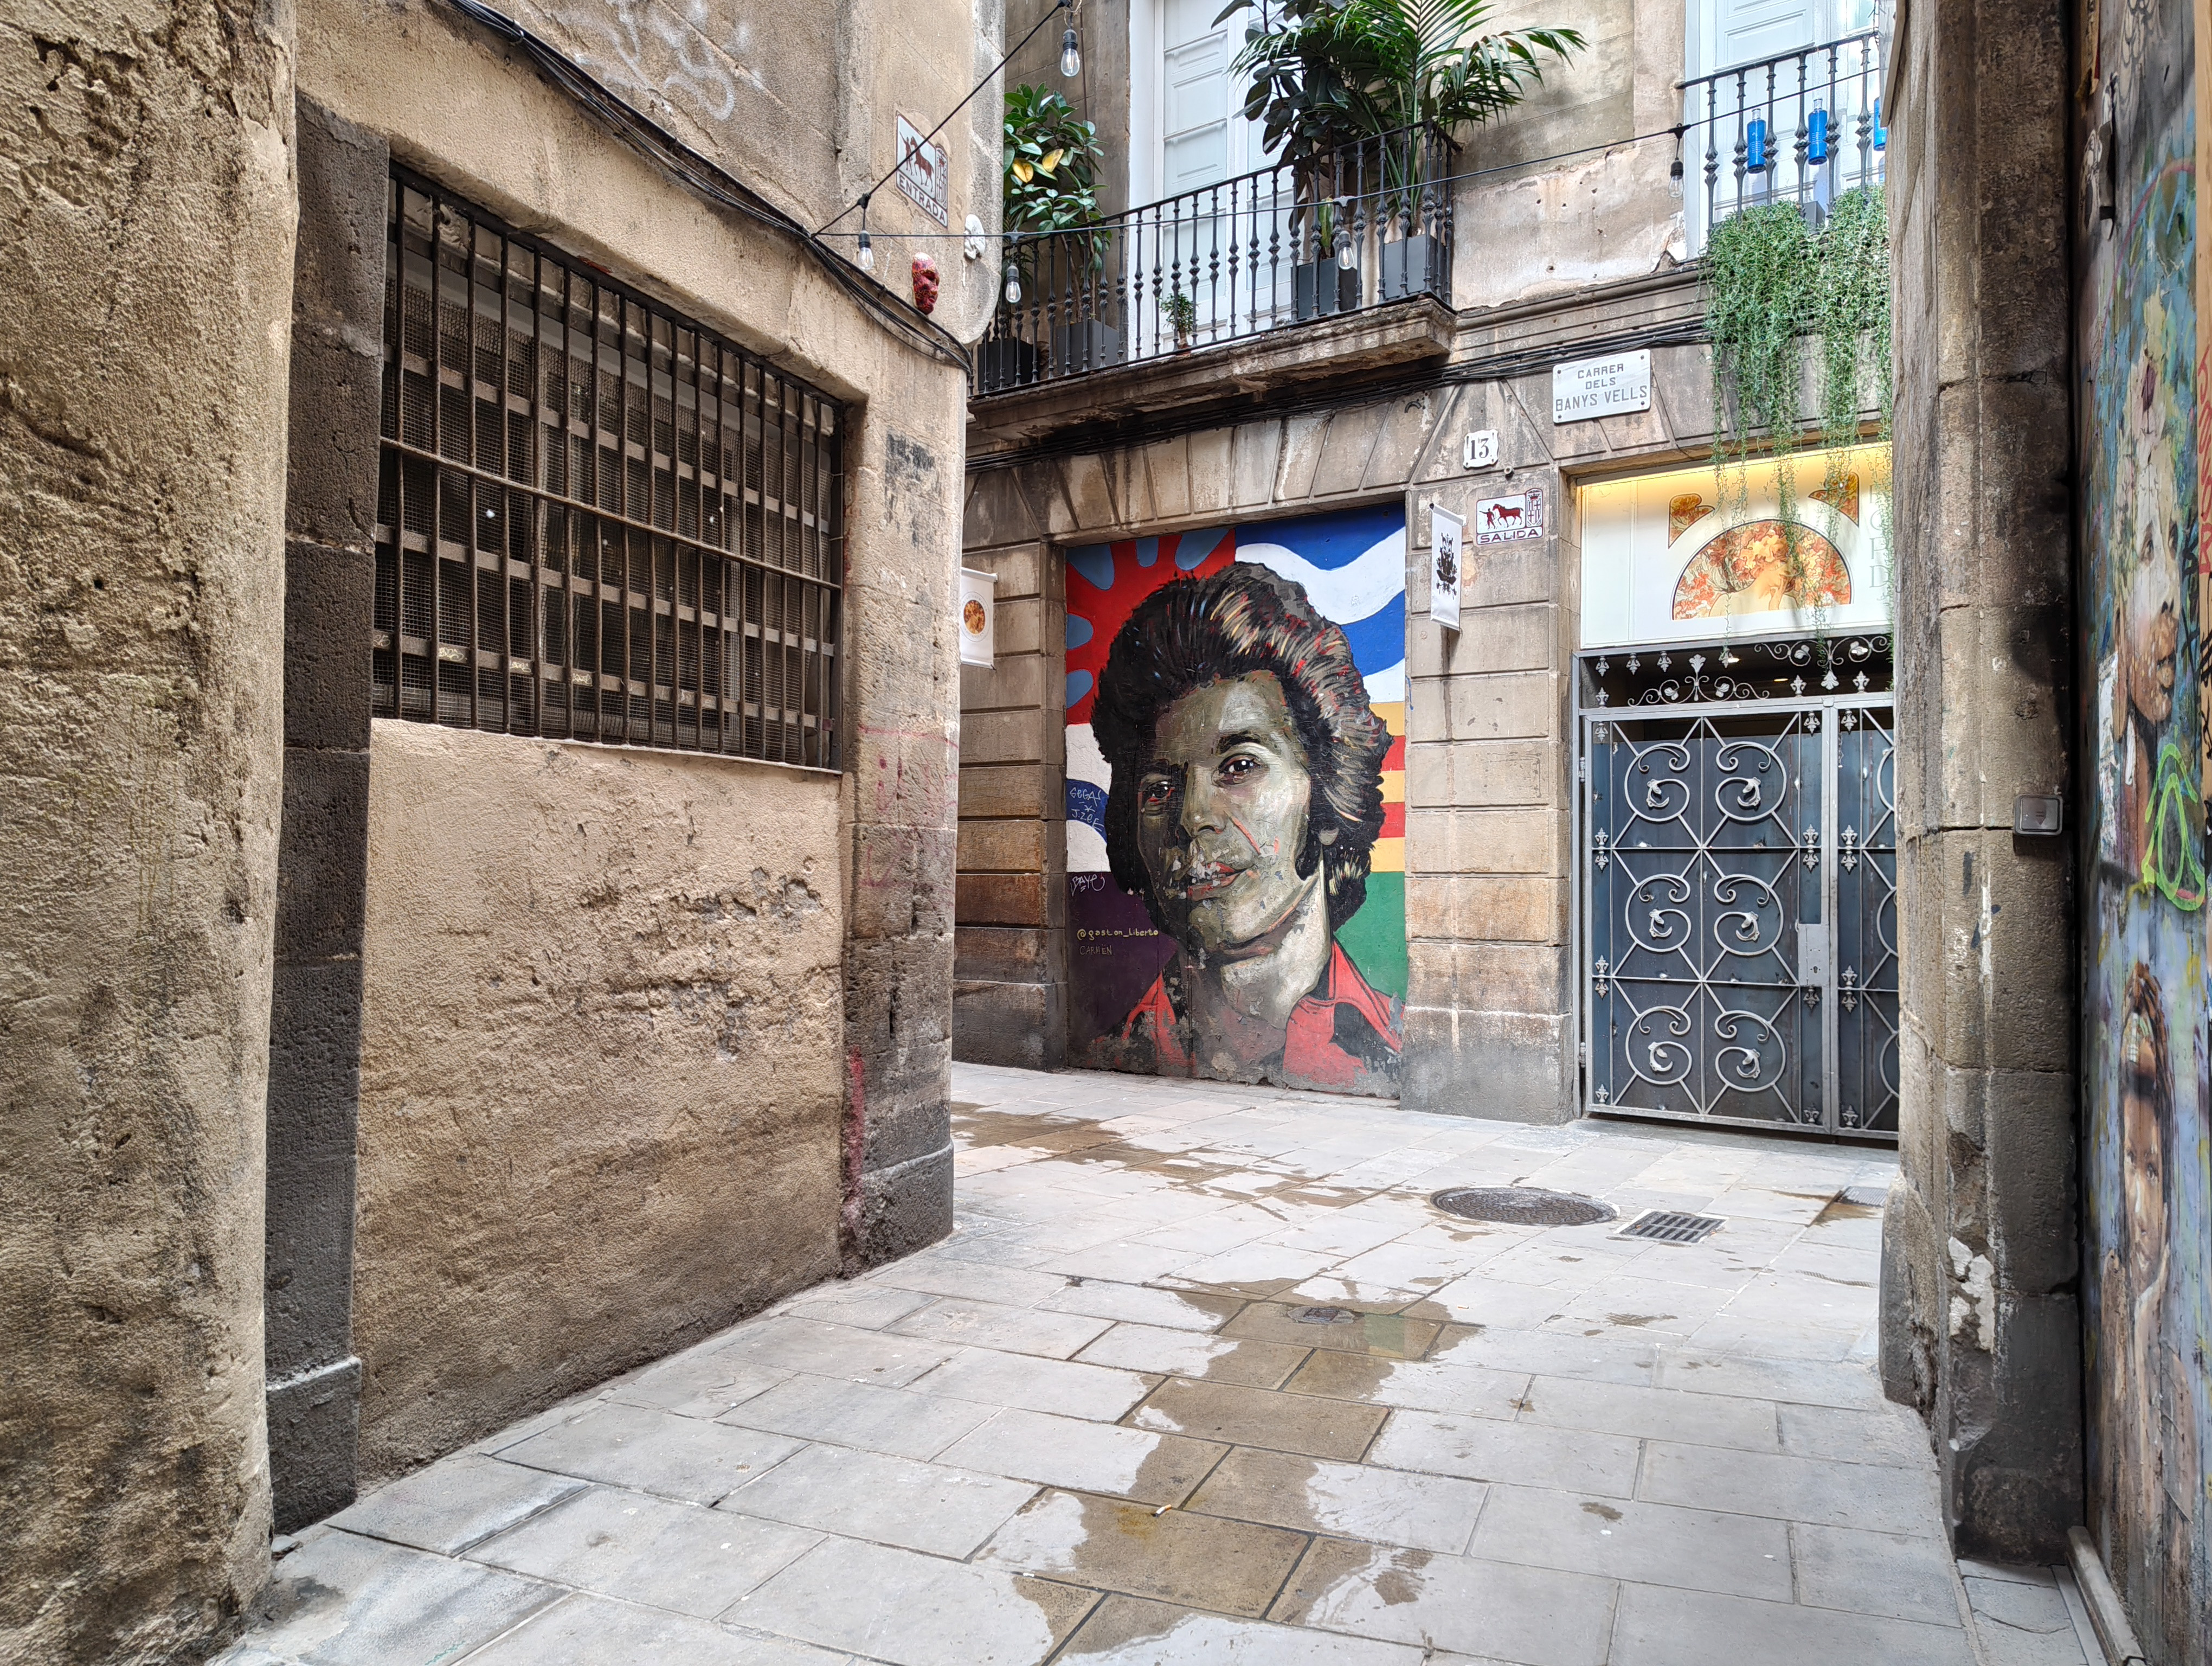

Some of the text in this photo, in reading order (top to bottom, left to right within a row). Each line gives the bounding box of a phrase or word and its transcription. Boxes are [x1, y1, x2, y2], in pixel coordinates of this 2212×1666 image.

[899, 174, 945, 224] ENTRADA
[1578, 363, 1624, 379] CARRER
[1585, 377, 1616, 389] DELS
[1555, 385, 1648, 412] BANYS VELLS
[1470, 438, 1489, 460] 13
[1480, 529, 1539, 543] SALIDA
